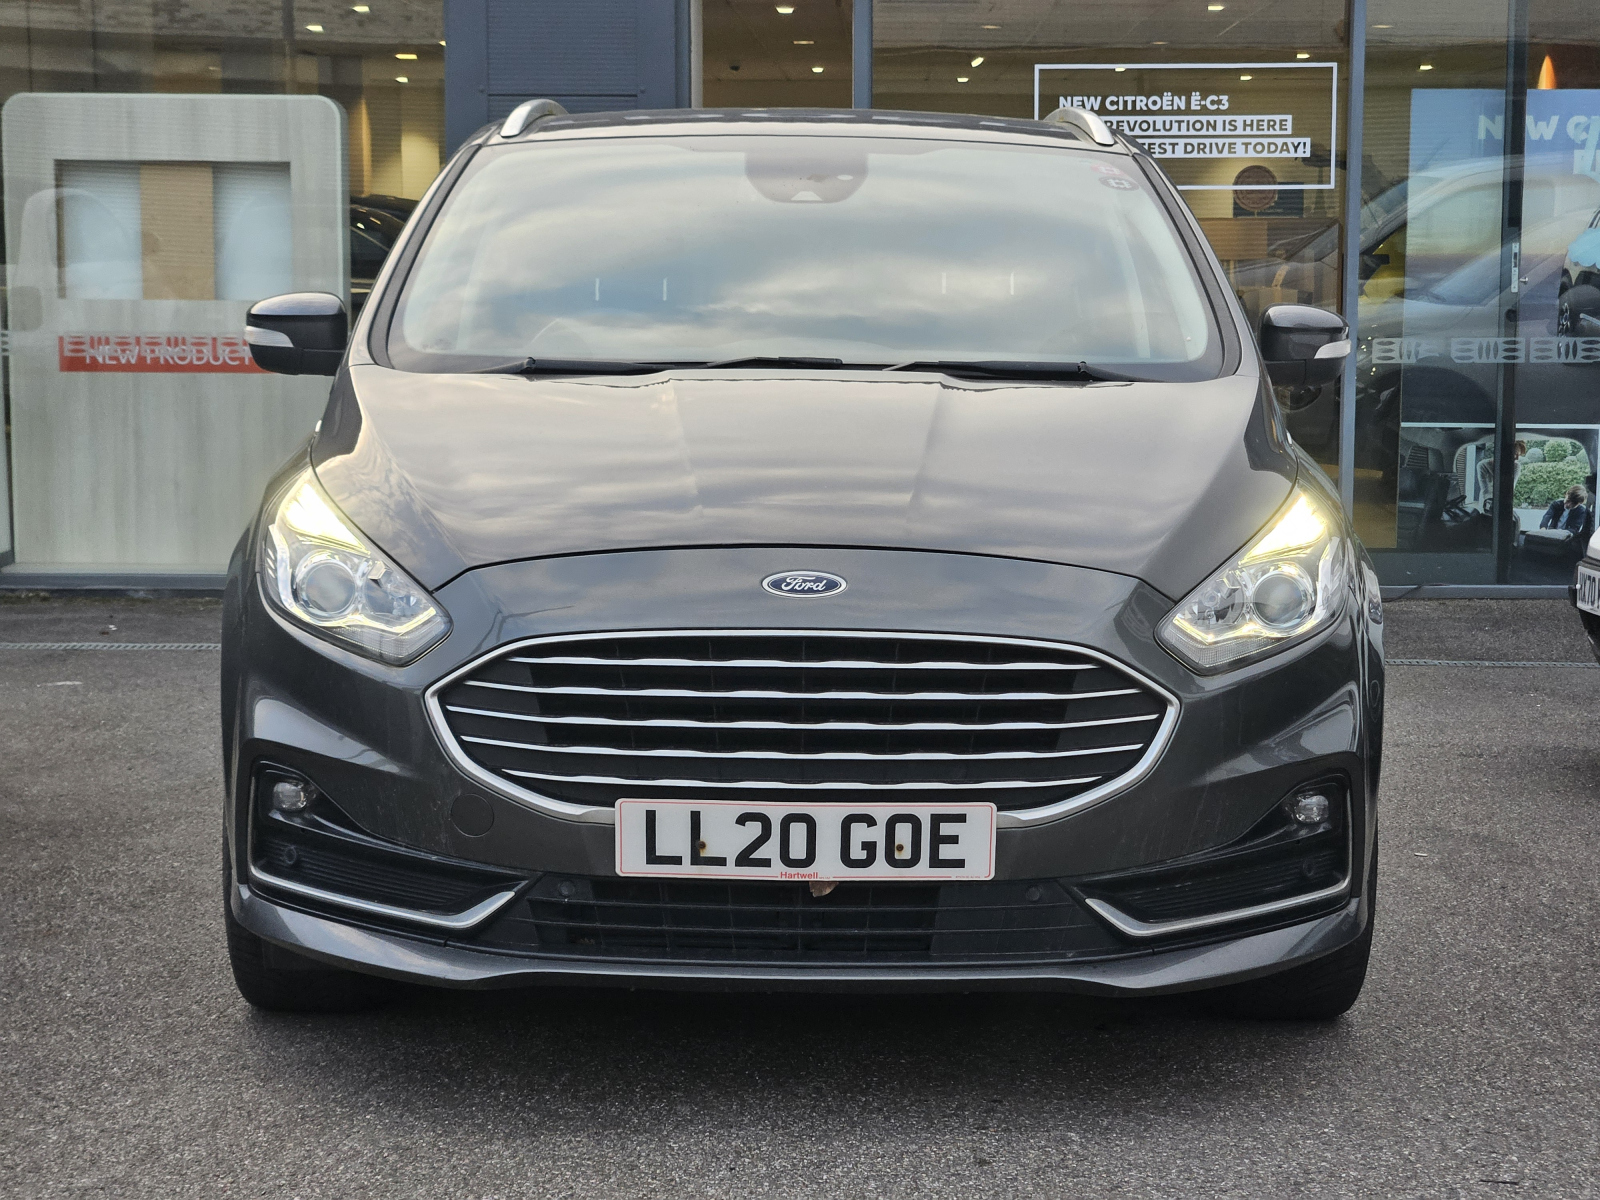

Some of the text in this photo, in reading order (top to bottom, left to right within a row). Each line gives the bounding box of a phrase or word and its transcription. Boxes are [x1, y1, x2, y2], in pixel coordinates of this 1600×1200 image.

[1059, 92, 1229, 111] NEW CITROËN Ë-C3
[1222, 119, 1237, 132] IS
[1243, 119, 1288, 132] HERE
[1478, 115, 1559, 140] NW
[1183, 141, 1238, 155] DRIVE
[1241, 141, 1307, 155] TODAY!
[85, 346, 139, 365] NEW
[781, 576, 827, 591] Ford
[645, 809, 967, 868] LL20 GOE
[780, 871, 818, 879] Hartwell
